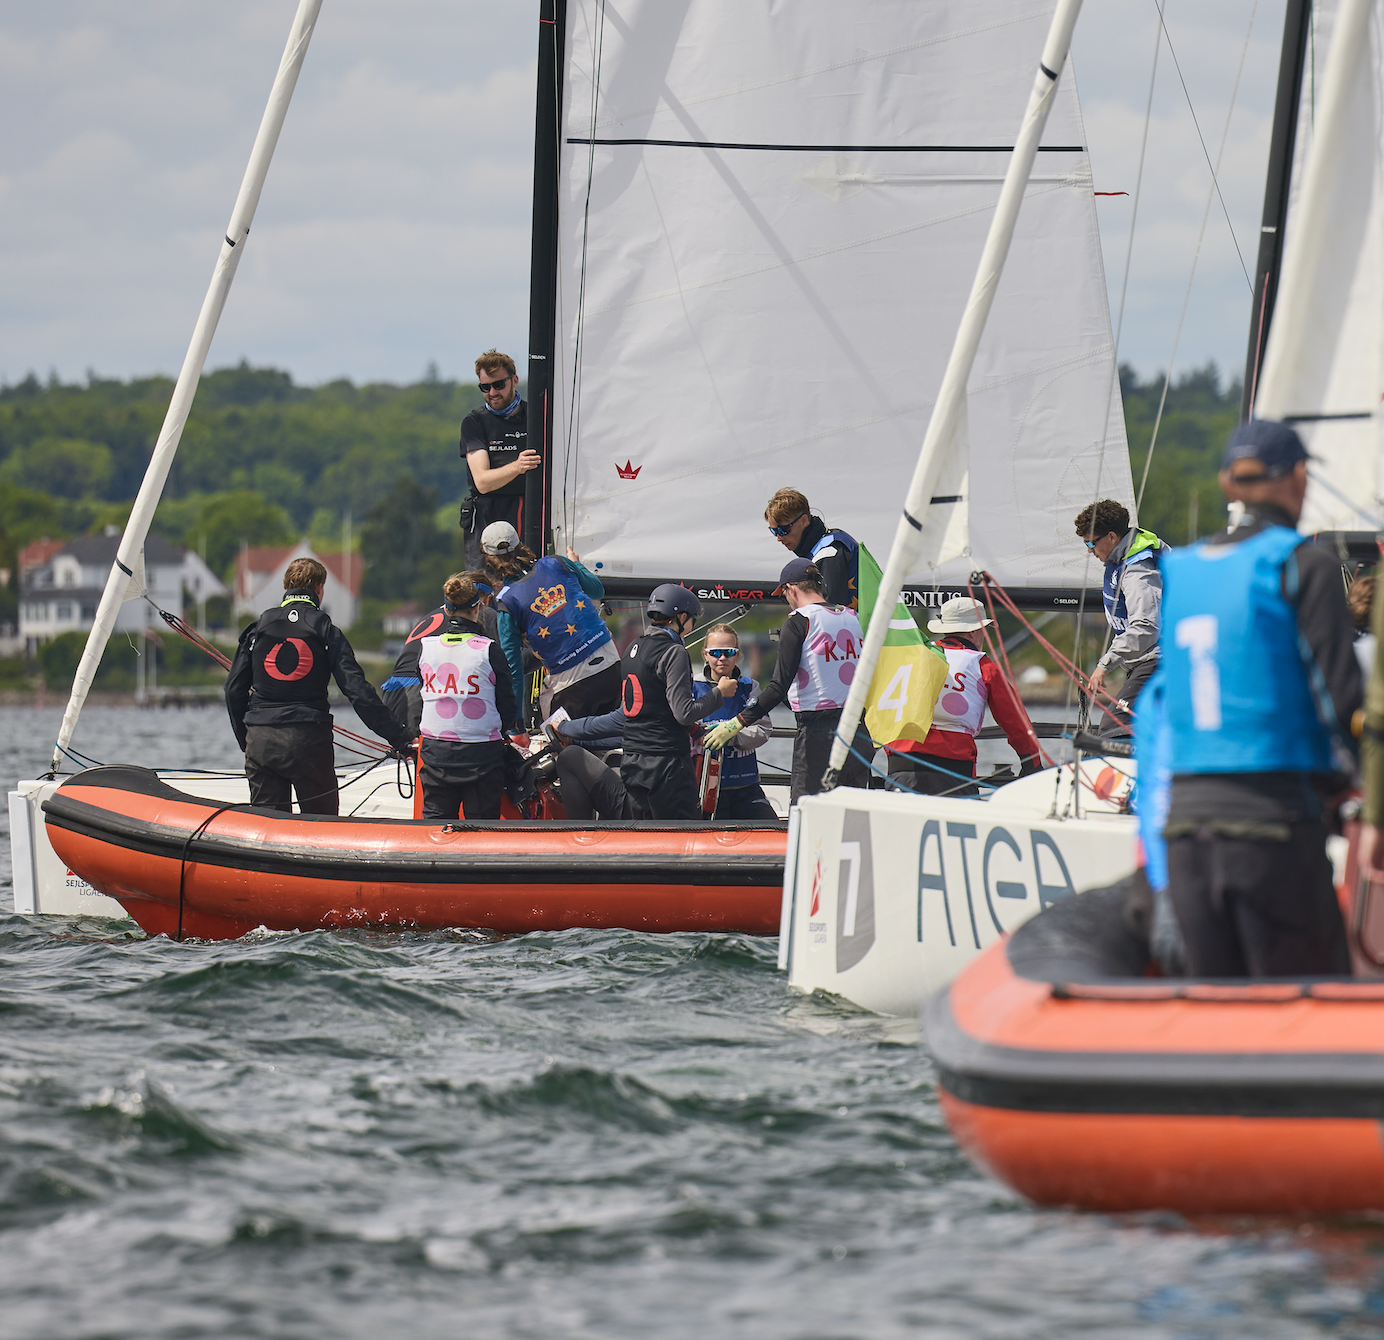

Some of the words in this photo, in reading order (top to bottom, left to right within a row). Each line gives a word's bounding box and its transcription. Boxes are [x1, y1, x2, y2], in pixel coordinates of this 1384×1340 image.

[697, 589, 764, 600] SAILWEAR
[825, 638, 864, 662] K.A.
[425, 673, 480, 695] K.A.S
[1175, 614, 1222, 732] 1
[877, 664, 913, 722] 4
[66, 880, 93, 888] SEJLSP
[80, 889, 107, 897] LIGAE
